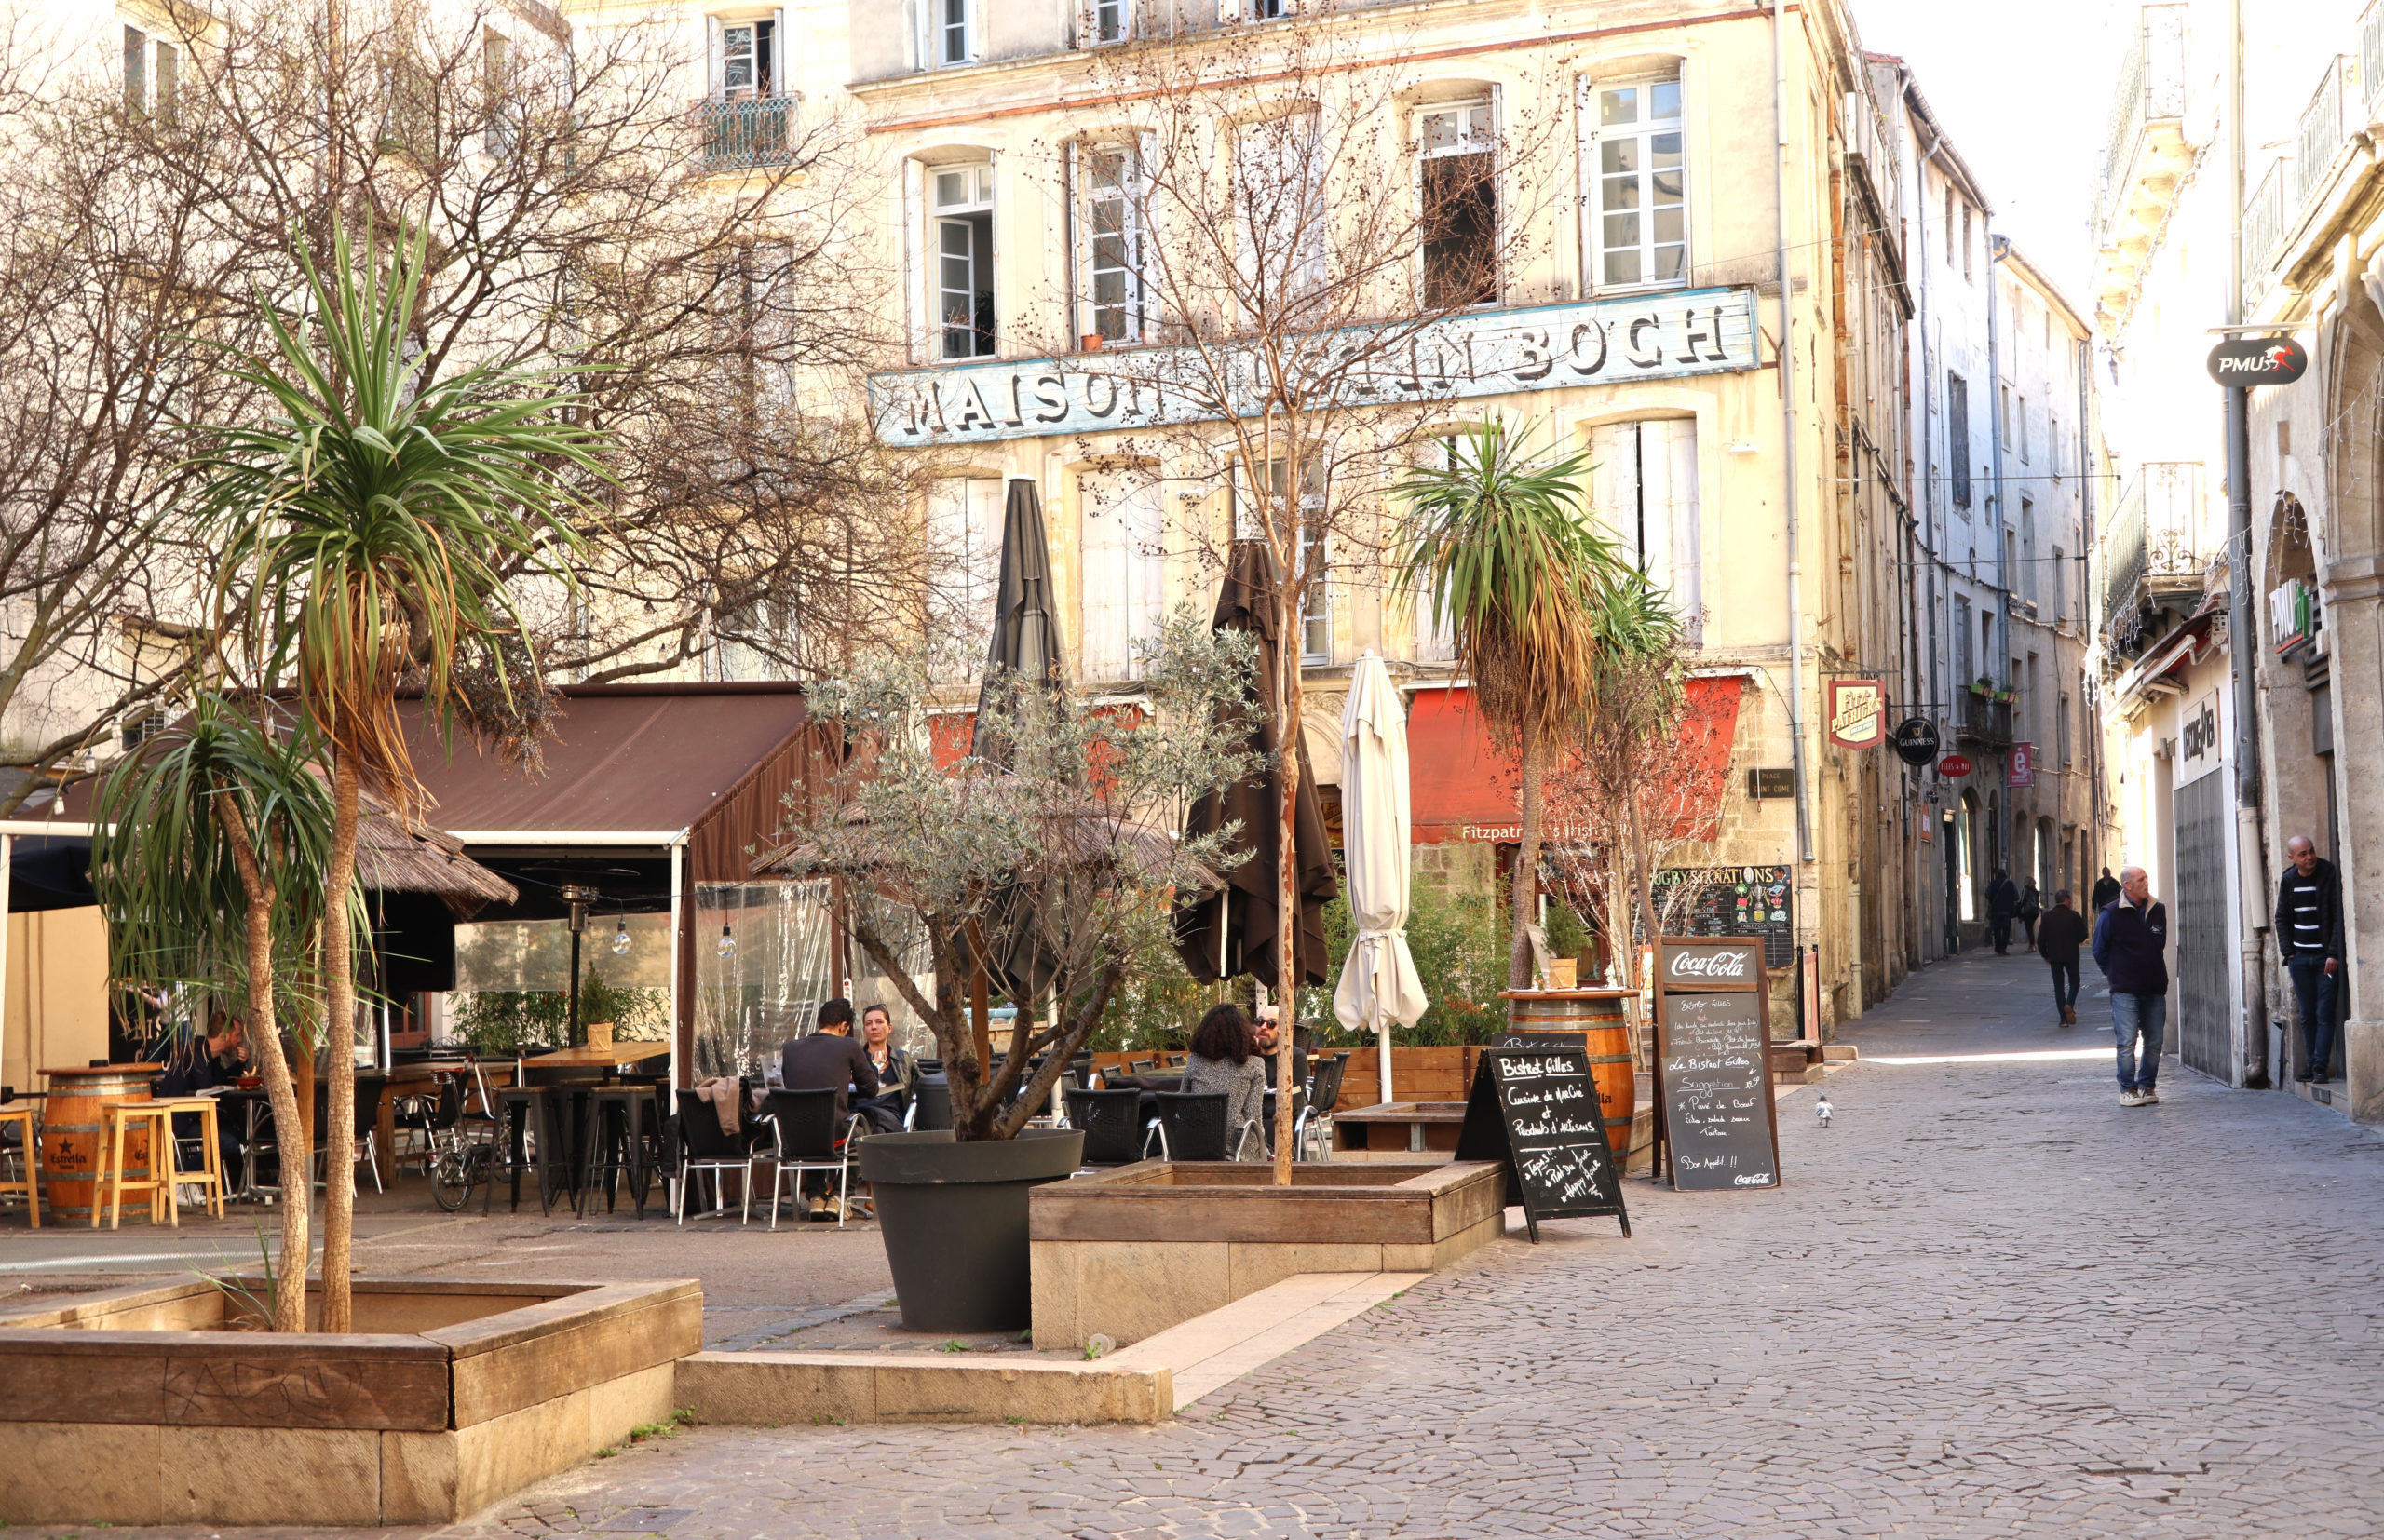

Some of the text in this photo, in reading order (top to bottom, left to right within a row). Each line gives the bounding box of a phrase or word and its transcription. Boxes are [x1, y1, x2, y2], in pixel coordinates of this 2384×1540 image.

[2218, 356, 2265, 372] PMU
[903, 361, 1166, 436] MAISON
[2269, 578, 2296, 645] PMU
[1753, 784, 1770, 793] SINT
[1714, 867, 1774, 884] NATIONS
[1671, 952, 1749, 977] Coca-Cola
[1725, 1056, 1750, 1067] Gilles
[1681, 1077, 1734, 1099] Suggestion
[1543, 1090, 1554, 1102] de
[1716, 1100, 1726, 1109] de
[1541, 1105, 1551, 1119] et
[50, 1152, 87, 1164] Estrella
[1681, 1155, 1701, 1169] Bon
[1734, 1173, 1770, 1185] Coca-Cola
